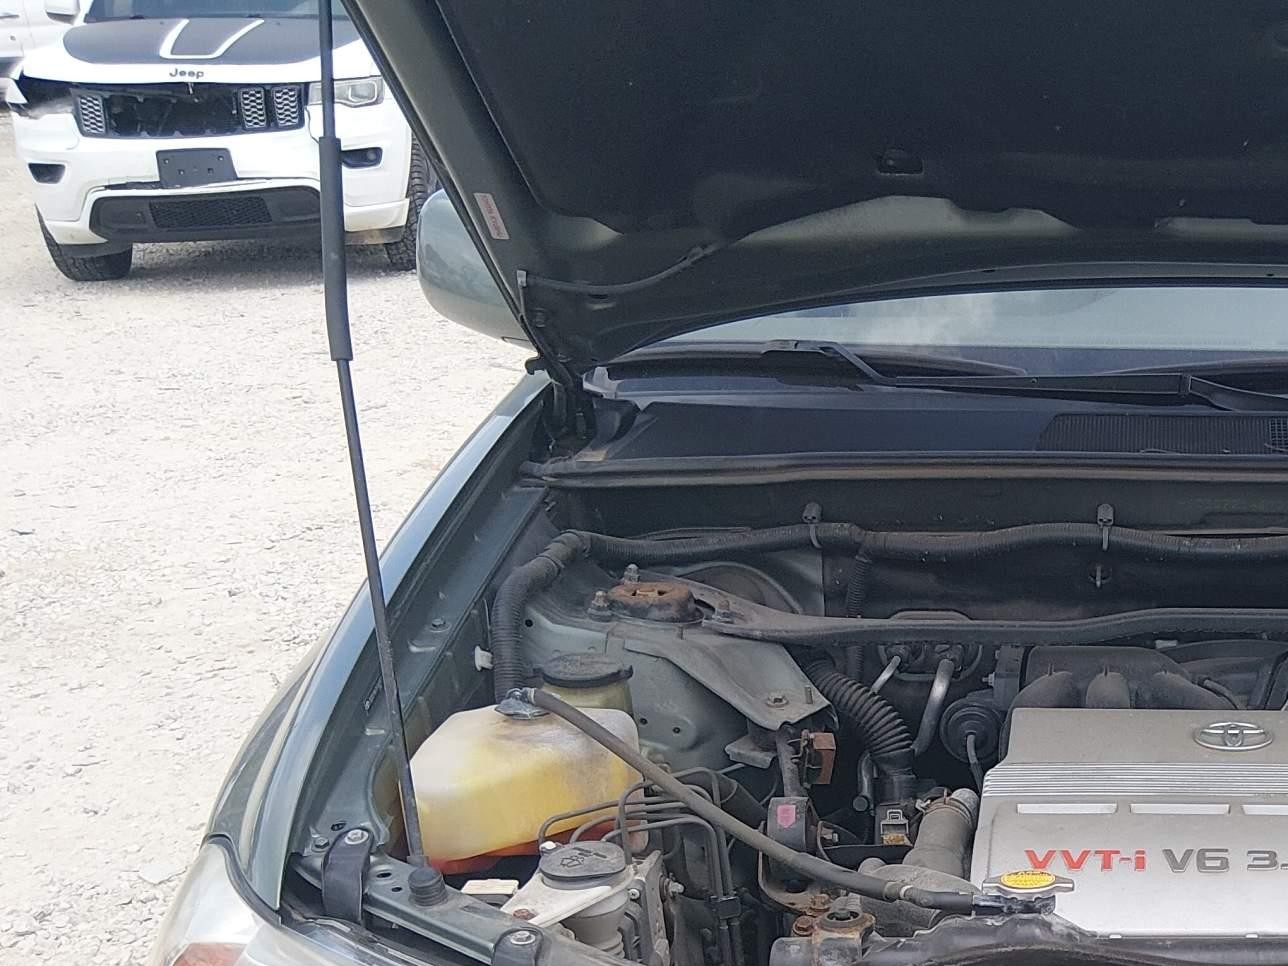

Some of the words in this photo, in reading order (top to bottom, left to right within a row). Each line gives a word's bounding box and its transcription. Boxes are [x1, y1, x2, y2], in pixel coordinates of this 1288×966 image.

[169, 67, 204, 80] Jeep
[1025, 848, 1146, 871] VVT-i
[1161, 848, 1229, 873] V6
